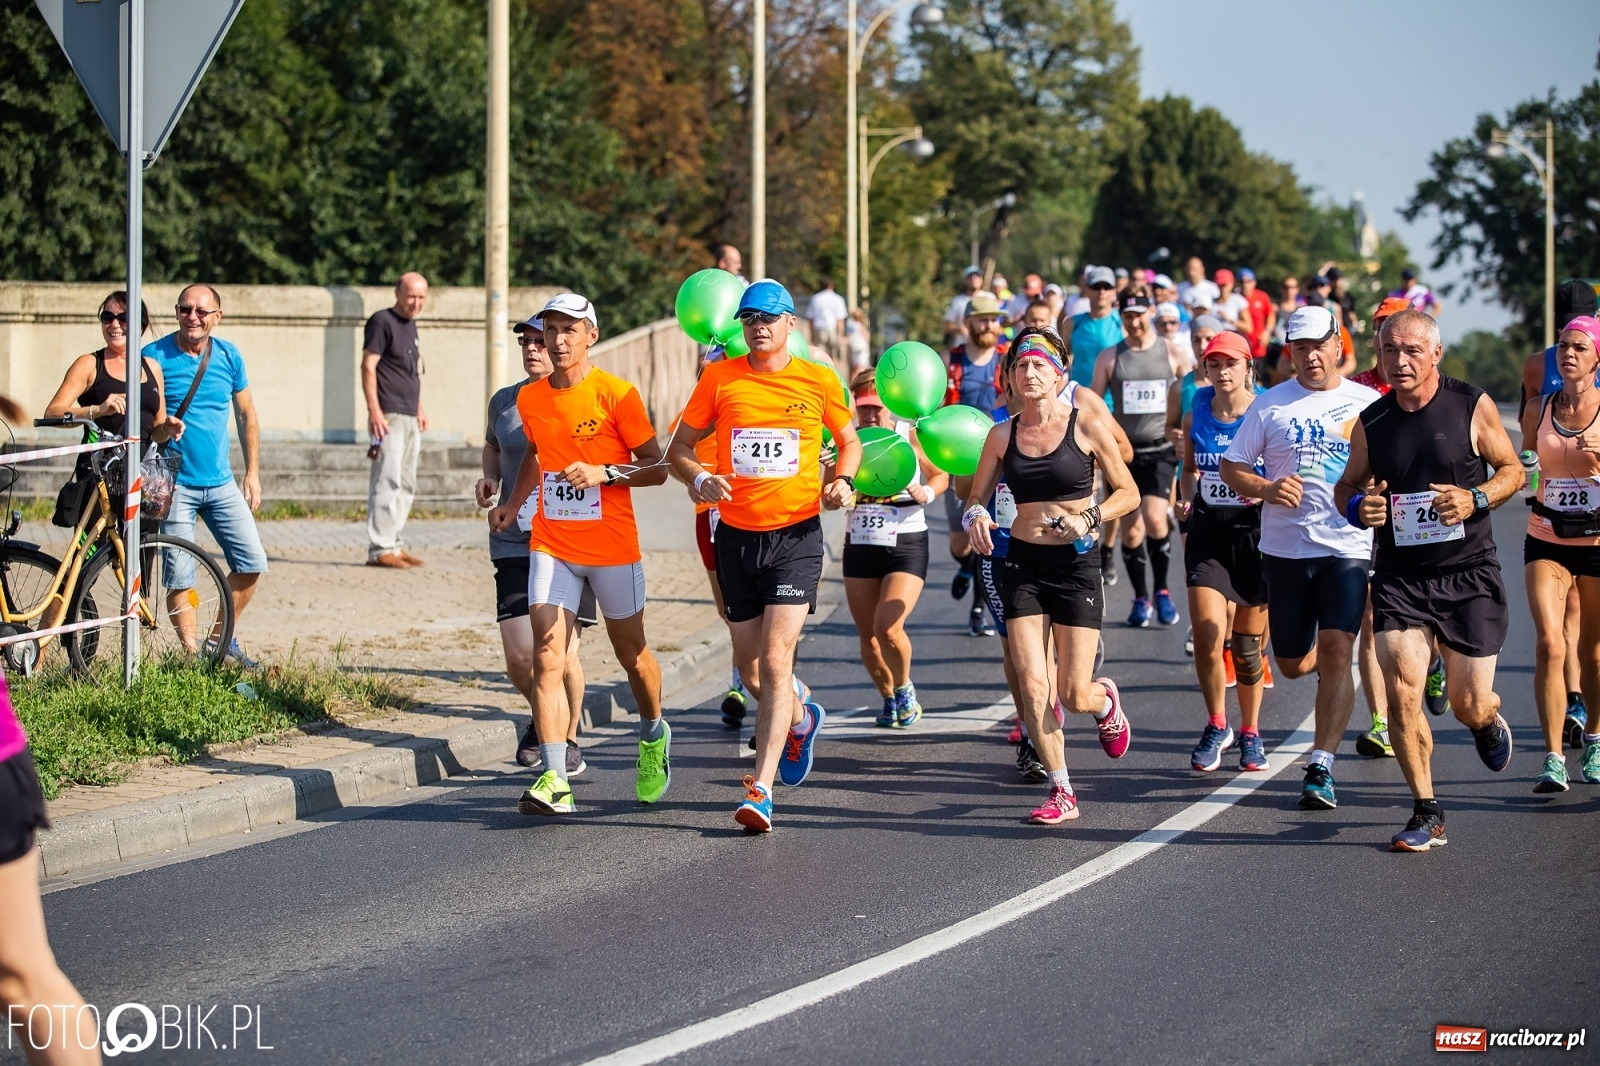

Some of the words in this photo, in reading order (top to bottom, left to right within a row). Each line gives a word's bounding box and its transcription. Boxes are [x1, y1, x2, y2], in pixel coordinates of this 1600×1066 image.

[751, 442, 783, 458] 215
[1328, 442, 1350, 453] 201
[555, 485, 585, 502] 450
[1209, 483, 1237, 498] 288
[1558, 491, 1589, 506] 228
[861, 515, 885, 528] 353
